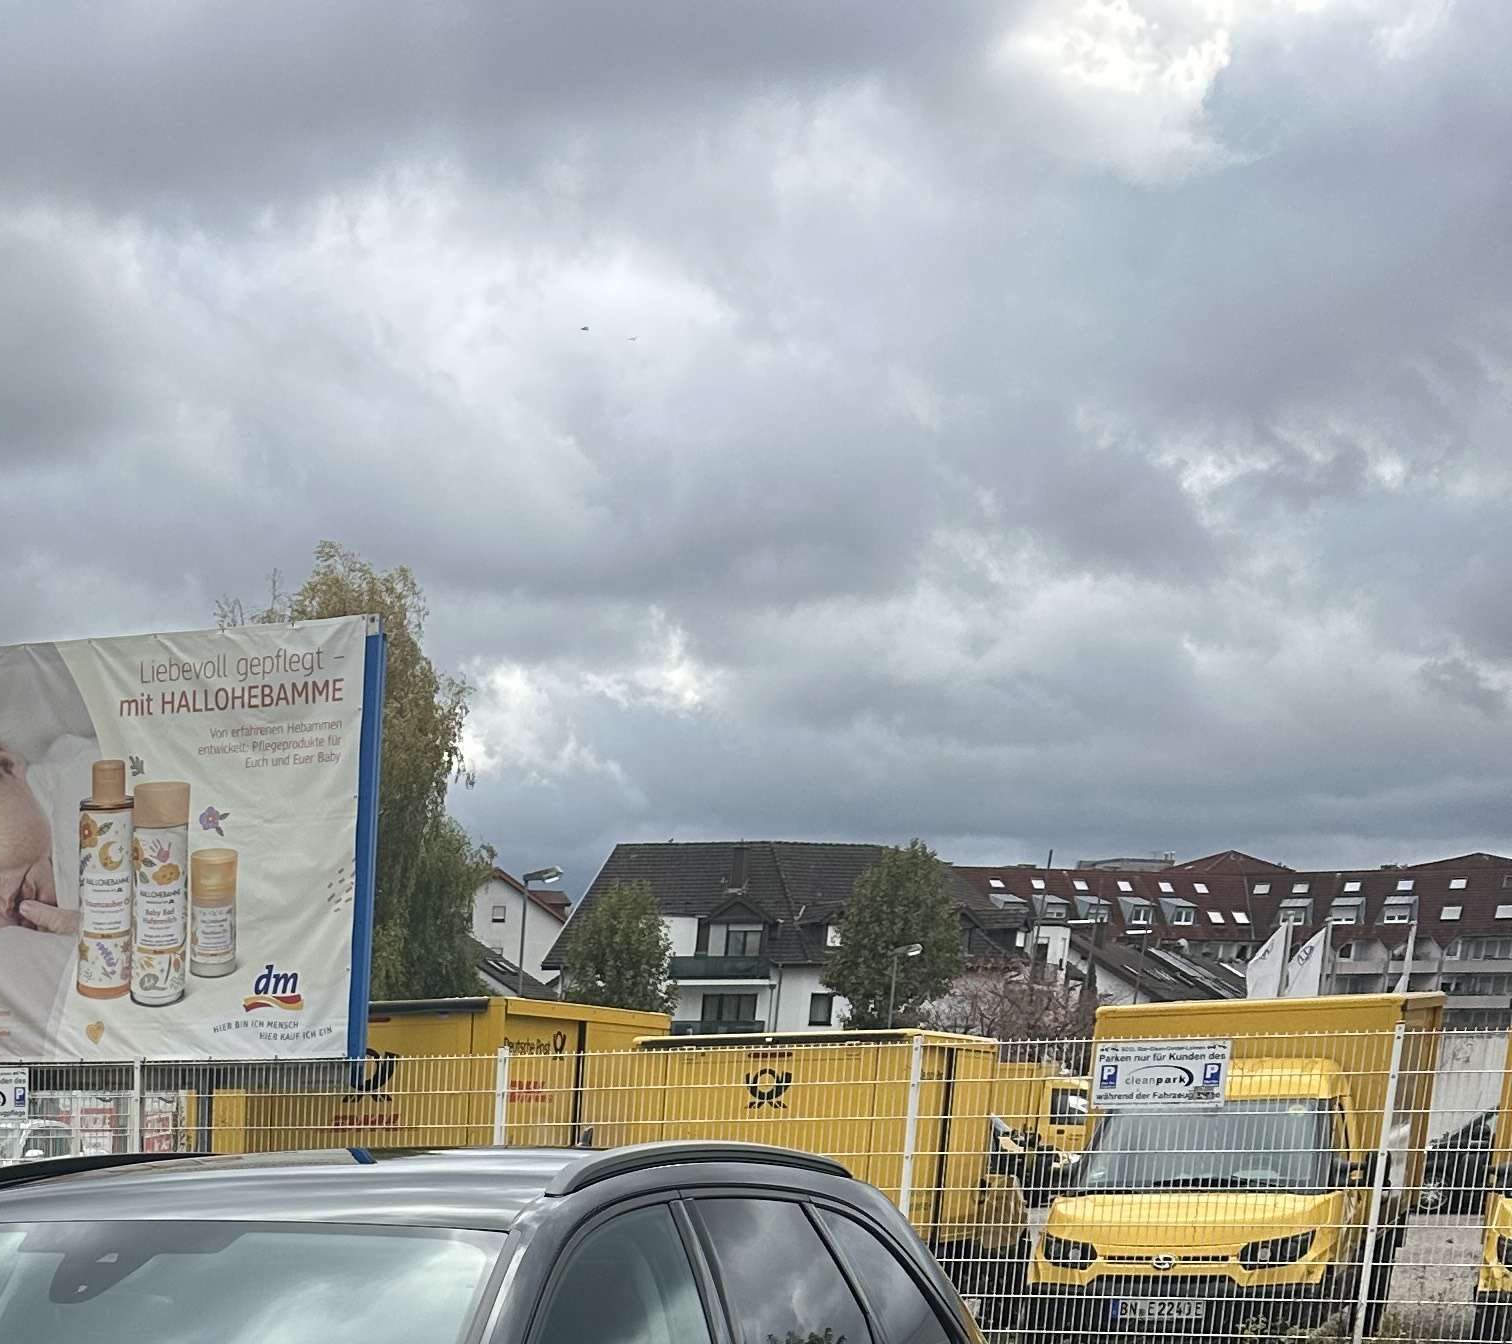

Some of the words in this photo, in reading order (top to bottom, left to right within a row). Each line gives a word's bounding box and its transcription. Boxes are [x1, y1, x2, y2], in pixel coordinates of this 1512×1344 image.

[139, 654, 229, 684] Liebevoll
[237, 647, 325, 682] gepflegt
[119, 692, 154, 718] mit
[160, 677, 346, 716] HALLOHEBAMME
[209, 727, 229, 740] Von
[230, 723, 284, 738] erfahrenen
[287, 719, 344, 735] Hebammen
[251, 737, 326, 754] Pflegeprodukte
[327, 734, 343, 748] für
[244, 756, 269, 769] Euch
[271, 754, 290, 768] und
[292, 752, 316, 765] Euer
[317, 750, 343, 766] Baby
[254, 964, 299, 995] dm
[212, 1023, 233, 1034] HIER
[234, 1020, 249, 1030] BIN
[250, 1019, 265, 1029] ICH
[266, 1020, 300, 1030] MENSCH
[258, 1031, 278, 1041] HIER
[279, 1033, 301, 1041] KAUF
[302, 1030, 317, 1041] ICH
[318, 1025, 334, 1038] EIN
[1098, 1054, 1133, 1063] Parken
[1152, 1052, 1167, 1062] für
[1168, 1051, 1206, 1061] Kunden
[1208, 1051, 1226, 1060] des
[1124, 1074, 1187, 1086] cleanpark
[1096, 1091, 1135, 1100] während
[1135, 1090, 1151, 1100] der
[1120, 1301, 1139, 1316] BN
